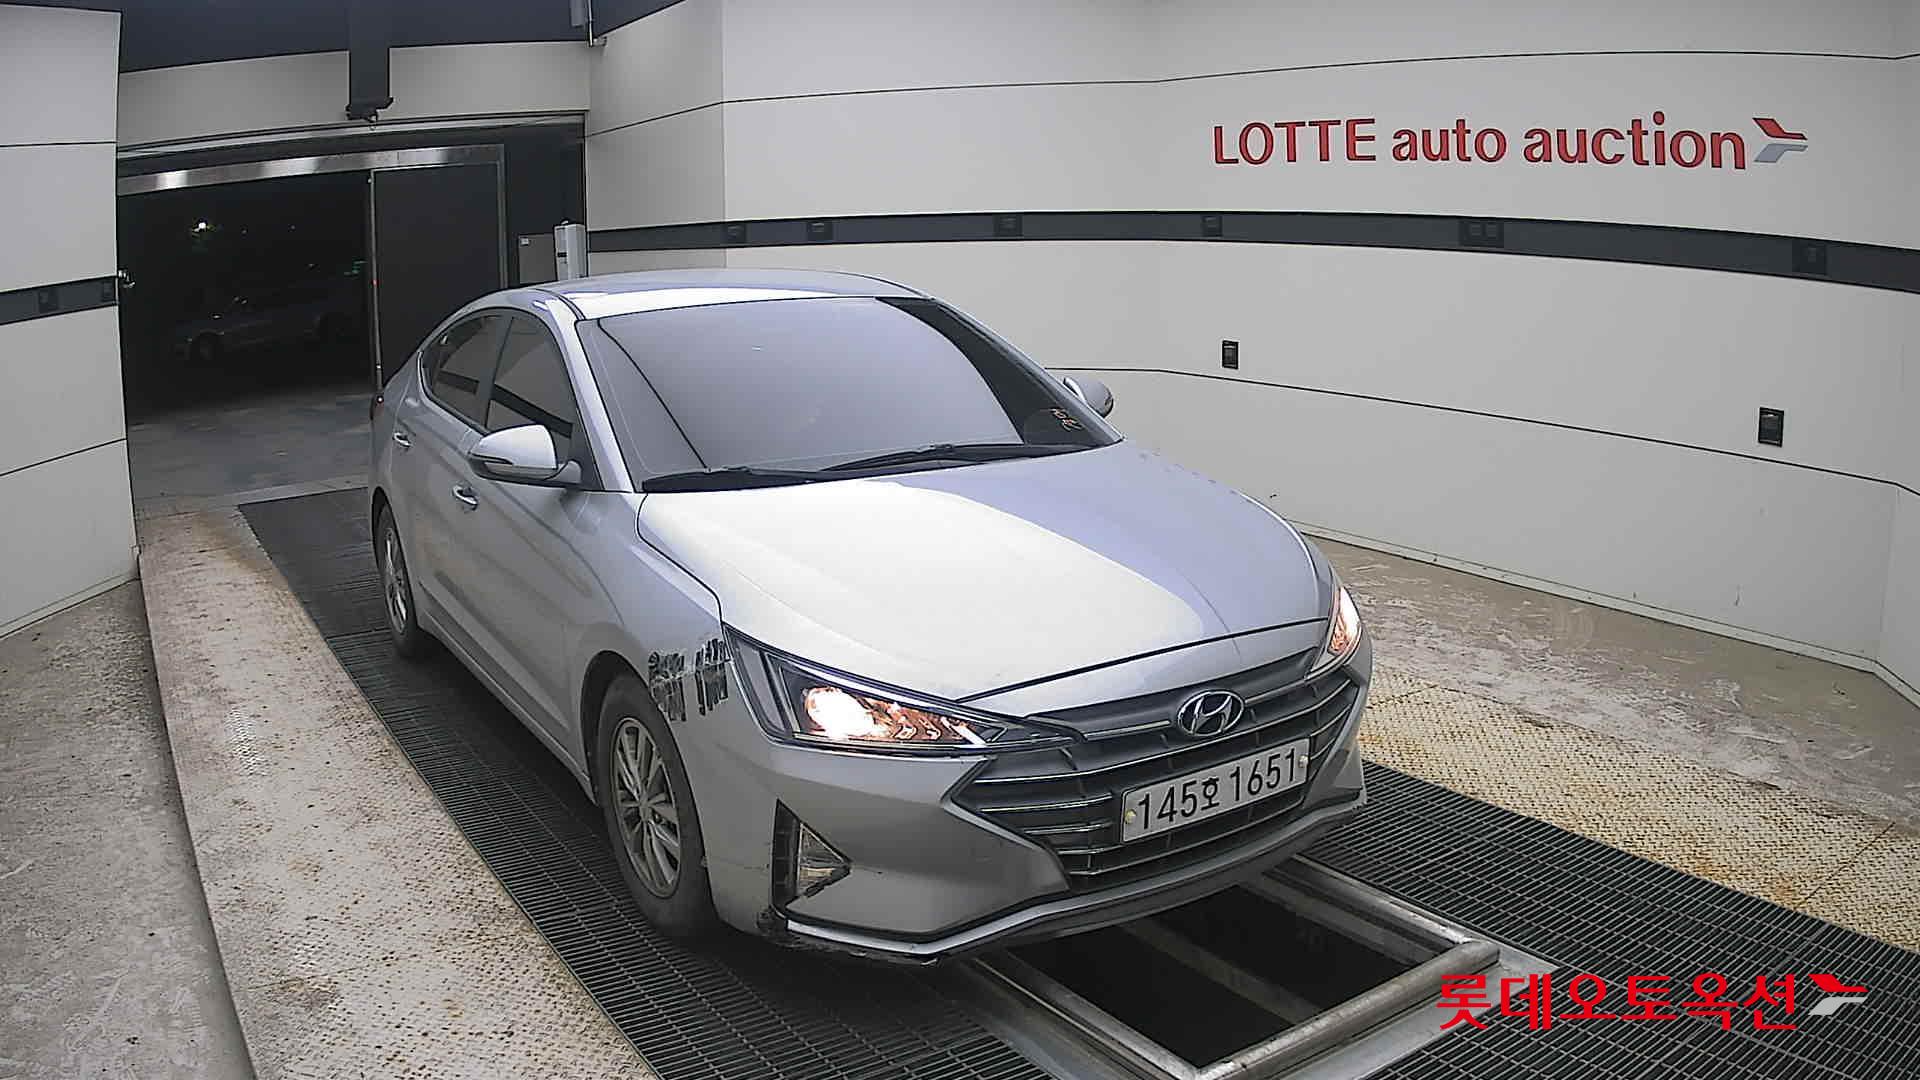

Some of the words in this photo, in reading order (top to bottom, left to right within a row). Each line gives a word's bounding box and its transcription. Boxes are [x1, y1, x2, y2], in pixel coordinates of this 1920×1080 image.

[1213, 118, 1376, 164] LOTTE
[1392, 118, 1507, 163] auto
[1523, 112, 1747, 170] auction
[1138, 777, 1219, 829] 145호
[1230, 747, 1296, 801] 1651
